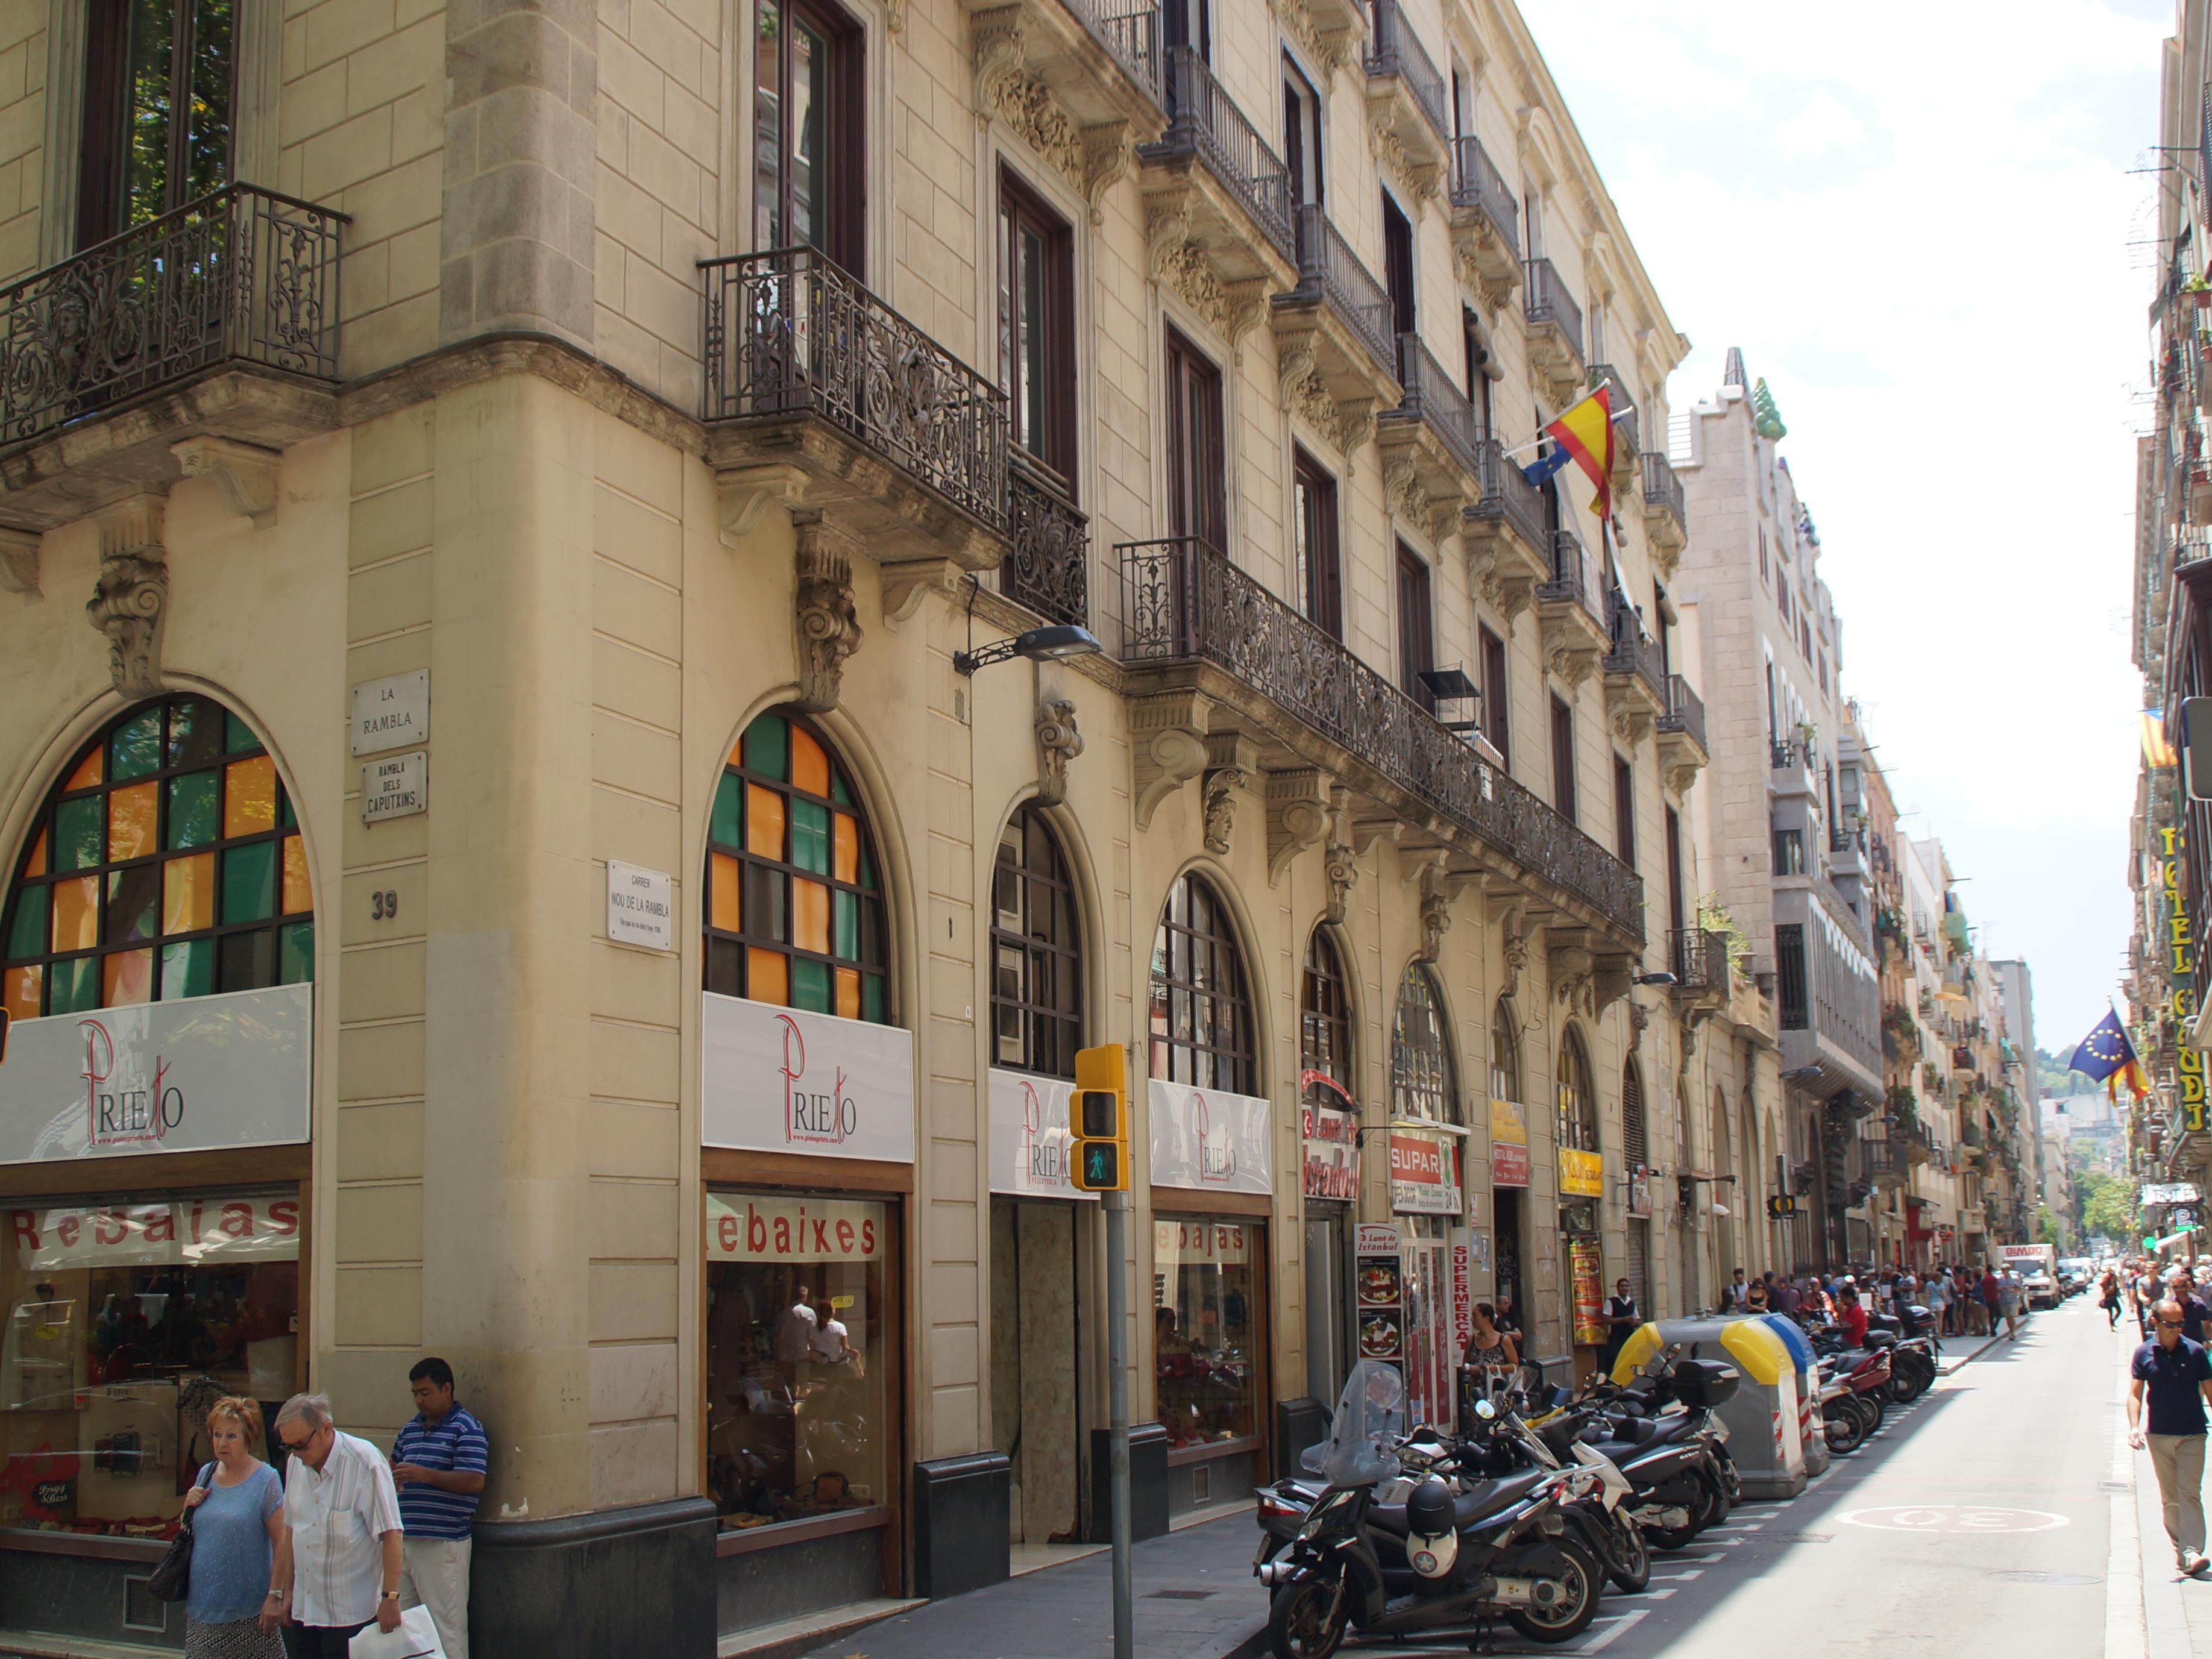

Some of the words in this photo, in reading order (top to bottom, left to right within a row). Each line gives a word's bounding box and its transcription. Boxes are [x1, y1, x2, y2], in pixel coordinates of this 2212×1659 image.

[381, 688, 394, 701] LA
[363, 712, 412, 735] RAMBLA
[379, 762, 404, 777] RAMBLA
[383, 780, 400, 792] DELS
[368, 791, 415, 814] CAPUTXINS
[631, 874, 650, 889] CARRER
[371, 889, 398, 920] 39
[611, 891, 625, 908] NOU
[626, 895, 635, 909] DE
[636, 898, 644, 912] LA
[646, 900, 669, 918] RAMBLA
[706, 1203, 875, 1255] ebaixes
[1157, 1219, 1243, 1257] ebajas
[1359, 1242, 1398, 1252] Istanbul
[2006, 1247, 2043, 1255] BIMBO
[1453, 1246, 1469, 1350] SUPERMERCAT
